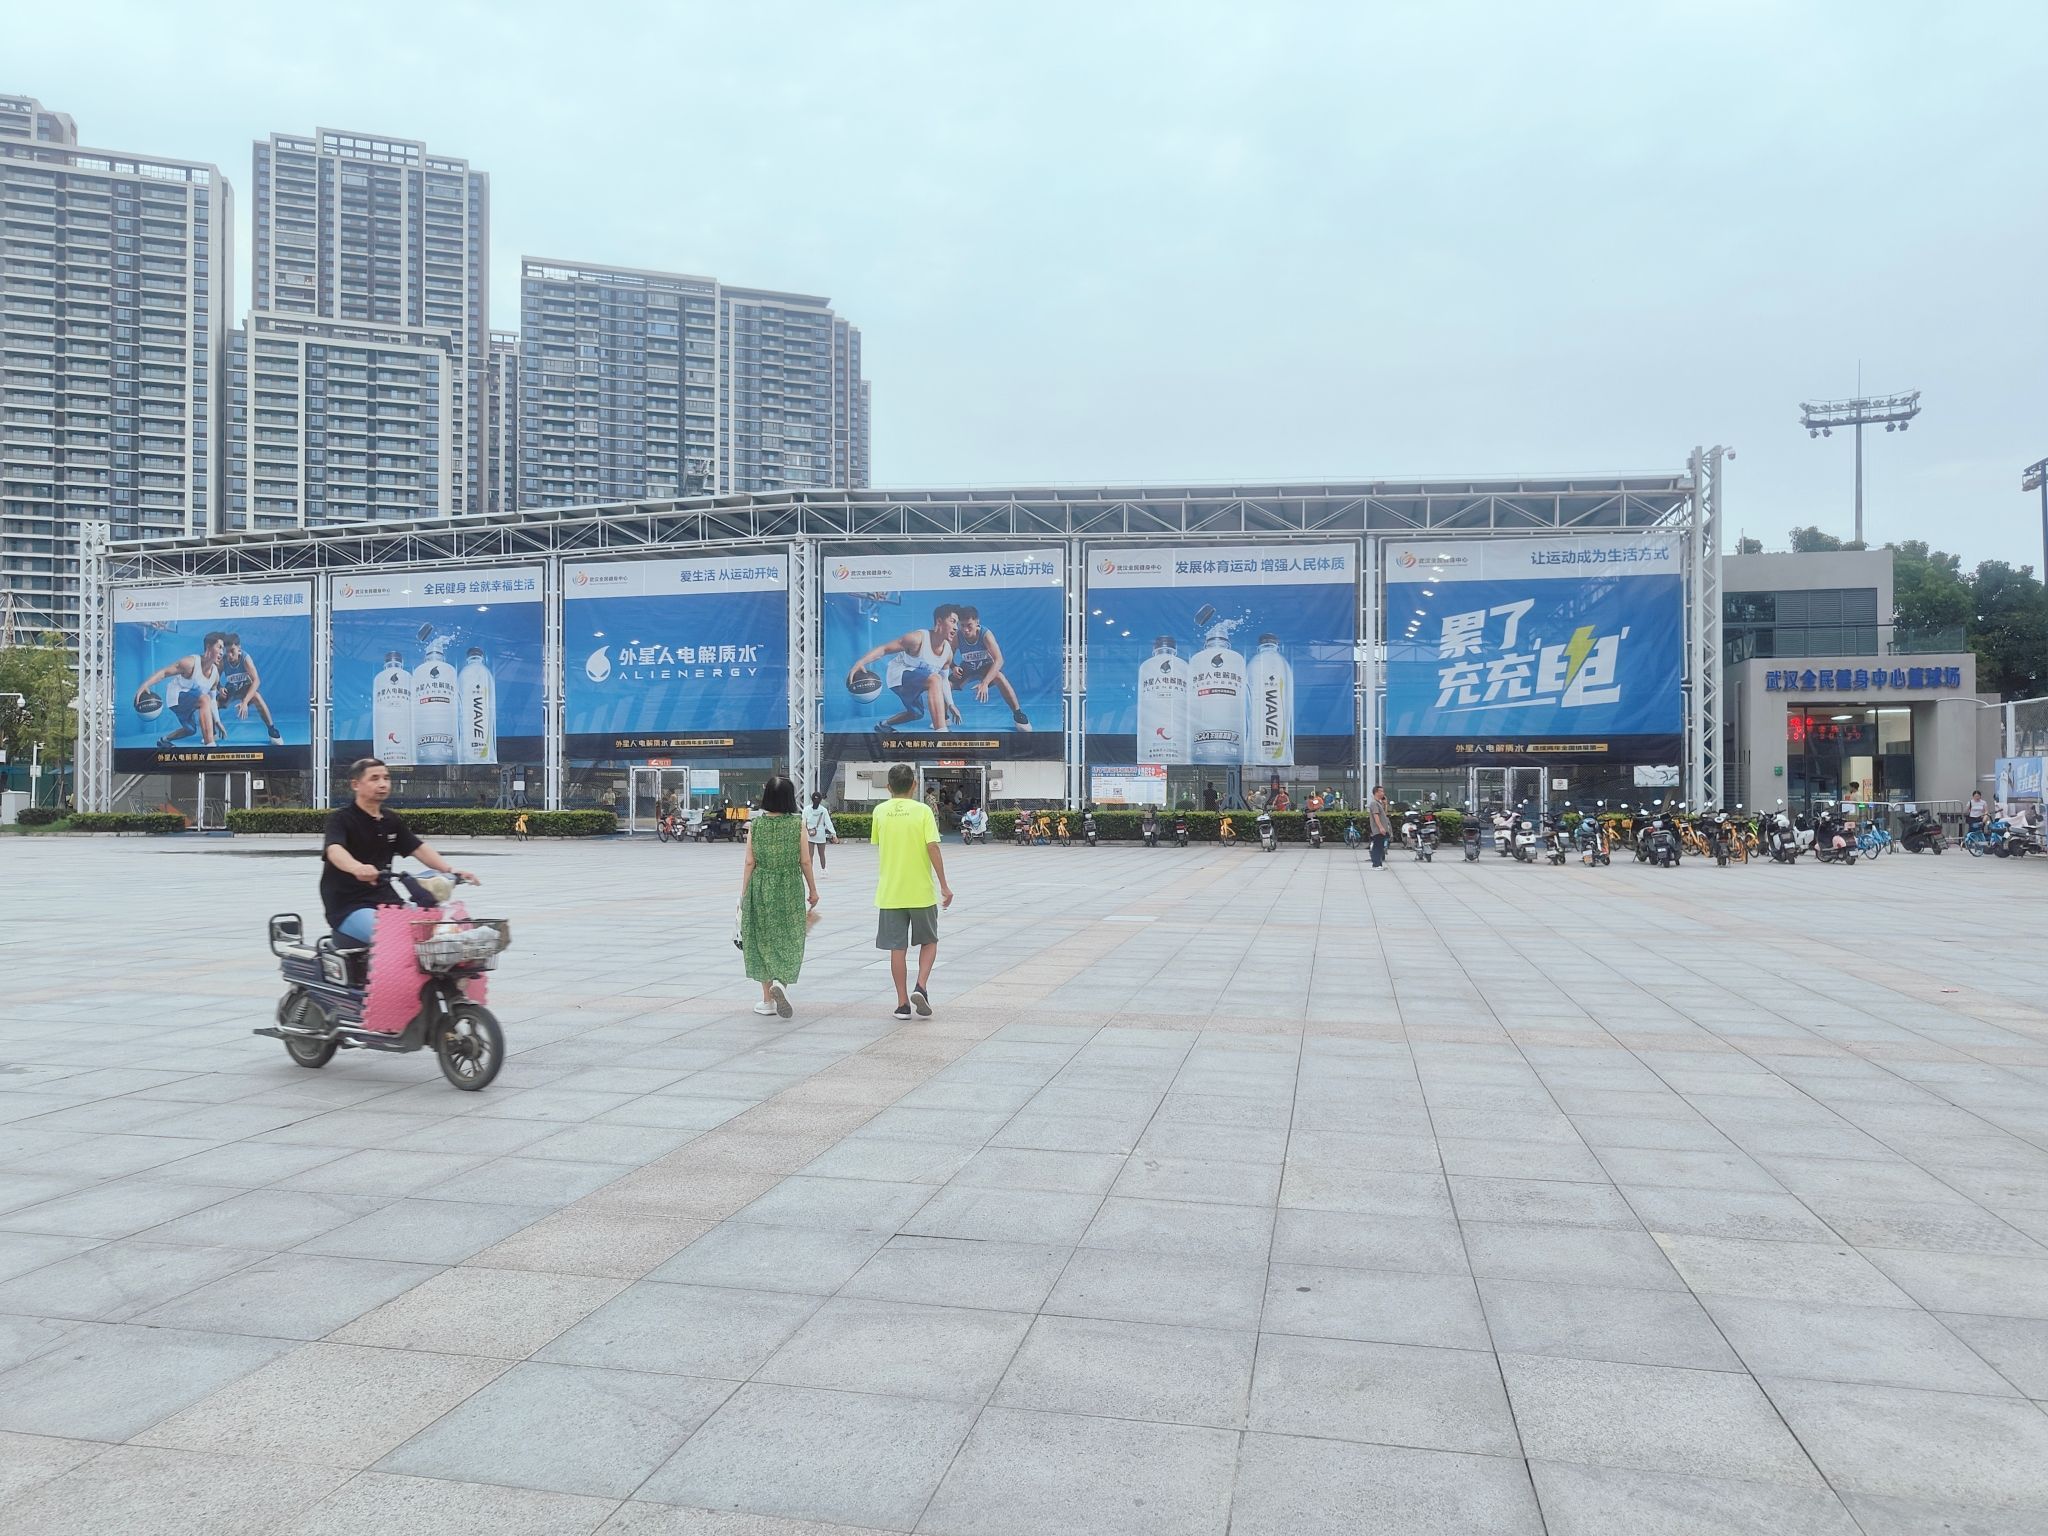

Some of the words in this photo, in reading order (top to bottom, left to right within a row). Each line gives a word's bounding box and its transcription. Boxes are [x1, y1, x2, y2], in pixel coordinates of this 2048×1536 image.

[1530, 547, 1669, 565] 让运动成为生活方式
[949, 564, 987, 578] 爱生活
[989, 562, 1054, 576] 从运动开始
[1175, 559, 1257, 574] 发展体育运动
[1260, 556, 1345, 571] 增强人民体质
[680, 569, 716, 583] 爱生活
[718, 567, 779, 581] 从运动开始
[424, 582, 467, 595] 全民健身
[469, 579, 535, 593] 绘就幸福生活
[219, 596, 259, 608] 全民健身
[262, 593, 304, 606] 全民健康
[1438, 598, 1536, 660] 累了
[618, 667, 758, 681] ALIENERGY
[1766, 667, 1961, 691] 武汉全民健身中心篮球场
[473, 697, 484, 739] WAVE
[1265, 689, 1278, 738] WAVE
[1455, 744, 1483, 753] 外星人
[1485, 743, 1525, 753] 电解质水
